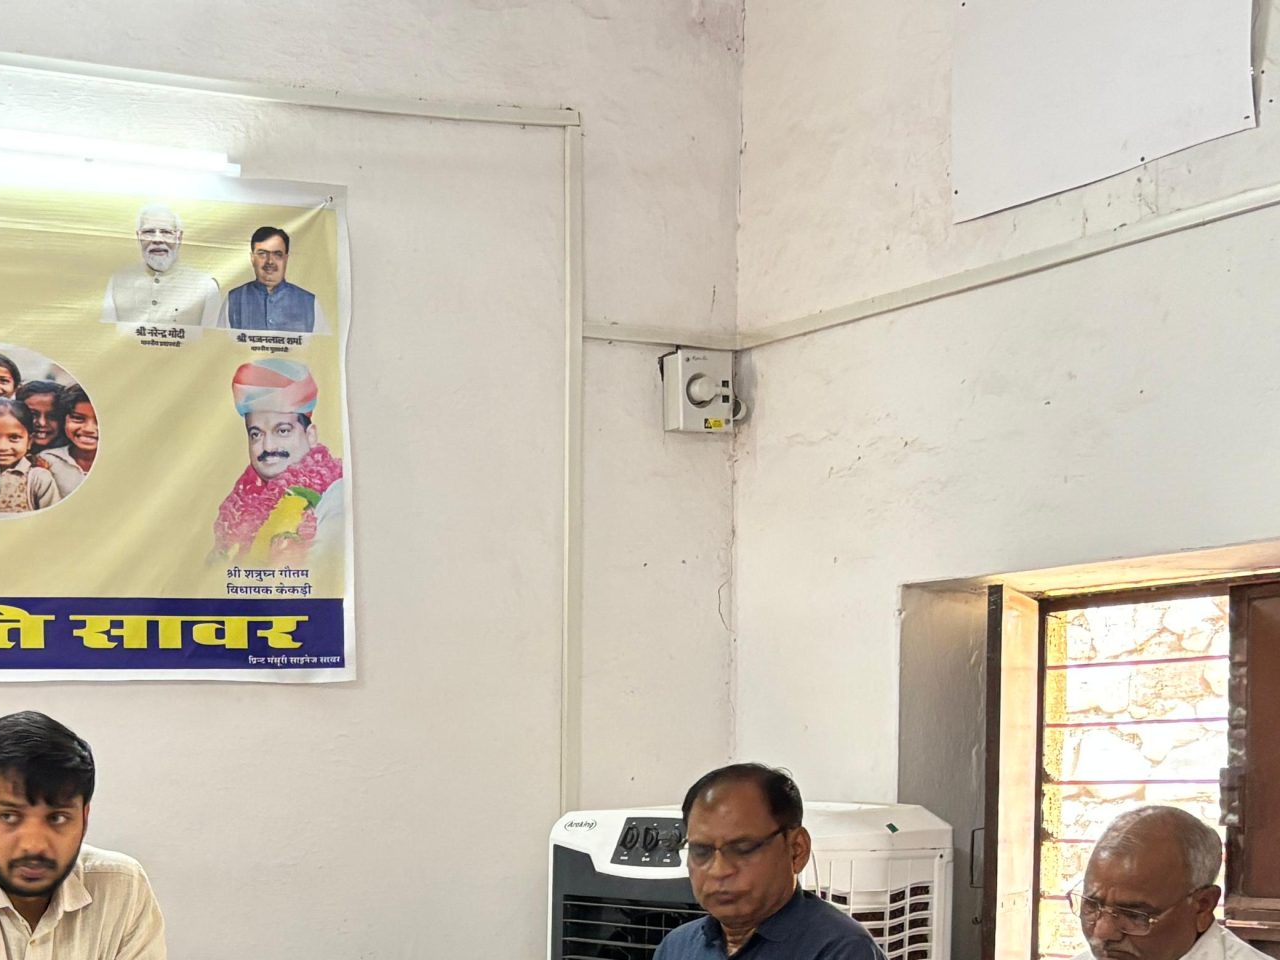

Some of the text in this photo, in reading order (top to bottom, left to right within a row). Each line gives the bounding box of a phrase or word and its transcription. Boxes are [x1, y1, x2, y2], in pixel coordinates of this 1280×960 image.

[168, 327, 185, 340] मोदी
[226, 566, 241, 579] श्री
[278, 565, 310, 579] गौतम
[226, 582, 272, 595] विधायक
[72, 614, 310, 649] सावर
